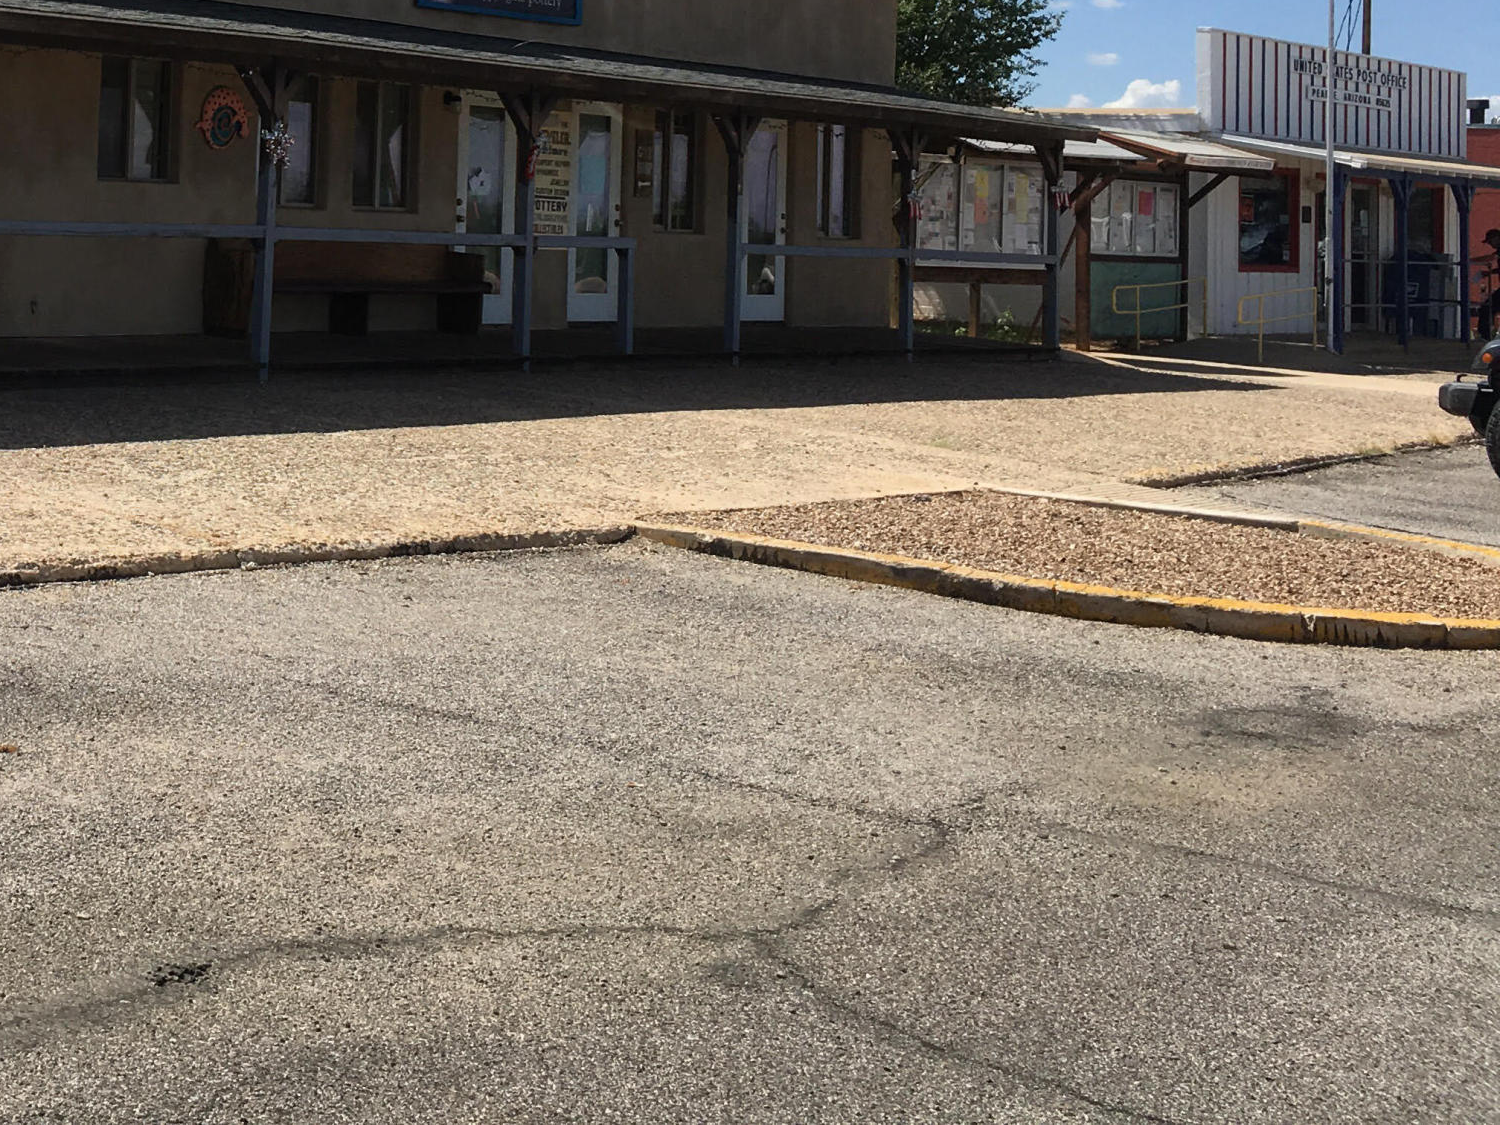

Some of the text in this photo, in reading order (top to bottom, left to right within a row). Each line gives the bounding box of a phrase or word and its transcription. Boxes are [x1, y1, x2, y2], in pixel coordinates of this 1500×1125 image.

[1293, 59, 1408, 89] UNITED ATES POST OFFICE
[1343, 92, 1371, 105] ARIZONA
[534, 199, 568, 212] OTTERY
